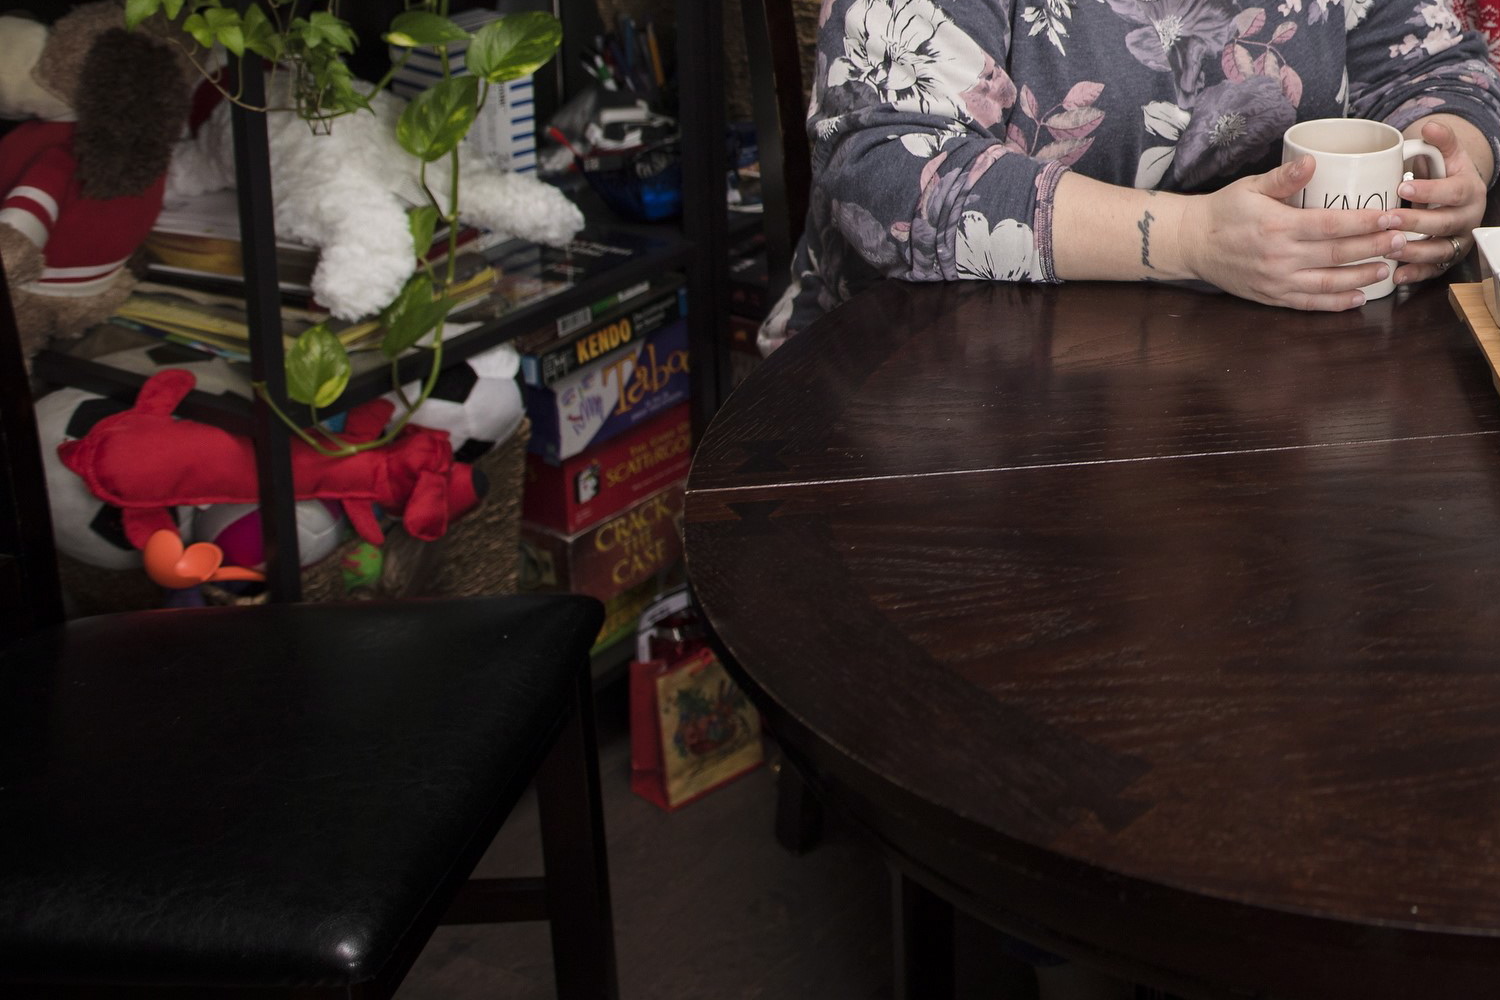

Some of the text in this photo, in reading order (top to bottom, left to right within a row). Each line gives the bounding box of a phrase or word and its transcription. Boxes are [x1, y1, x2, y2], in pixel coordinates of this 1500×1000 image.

[576, 317, 632, 365] KENDO
[595, 491, 672, 552] CRACK
[612, 537, 666, 585] CASE
